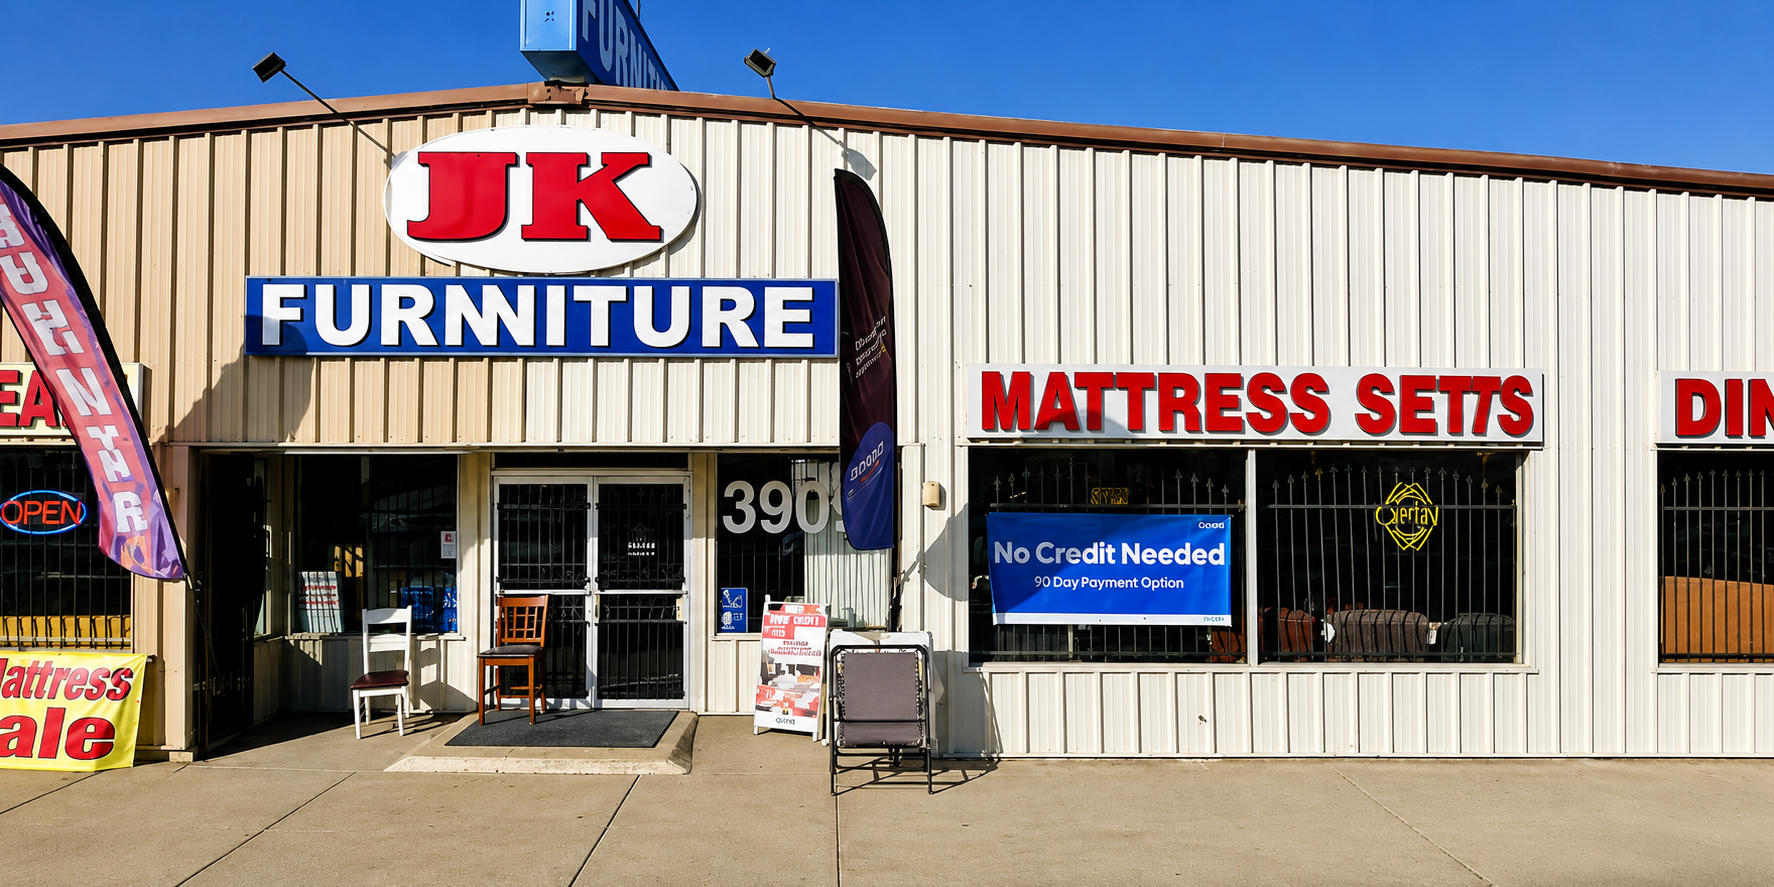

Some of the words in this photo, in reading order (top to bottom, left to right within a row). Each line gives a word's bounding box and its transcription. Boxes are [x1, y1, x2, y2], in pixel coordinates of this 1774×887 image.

[582, 0, 667, 91] FURNIT
[407, 151, 663, 243] JK
[981, 370, 1331, 435] MATTRESS
[1, 500, 82, 525] OPEN
[994, 541, 1030, 565] No
[1035, 541, 1116, 565] Credit
[1121, 542, 1225, 566] Needed
[1034, 575, 1051, 588] 90
[1053, 576, 1079, 590] Day
[1081, 576, 1138, 591] Payment
[1141, 576, 1184, 591] Option
